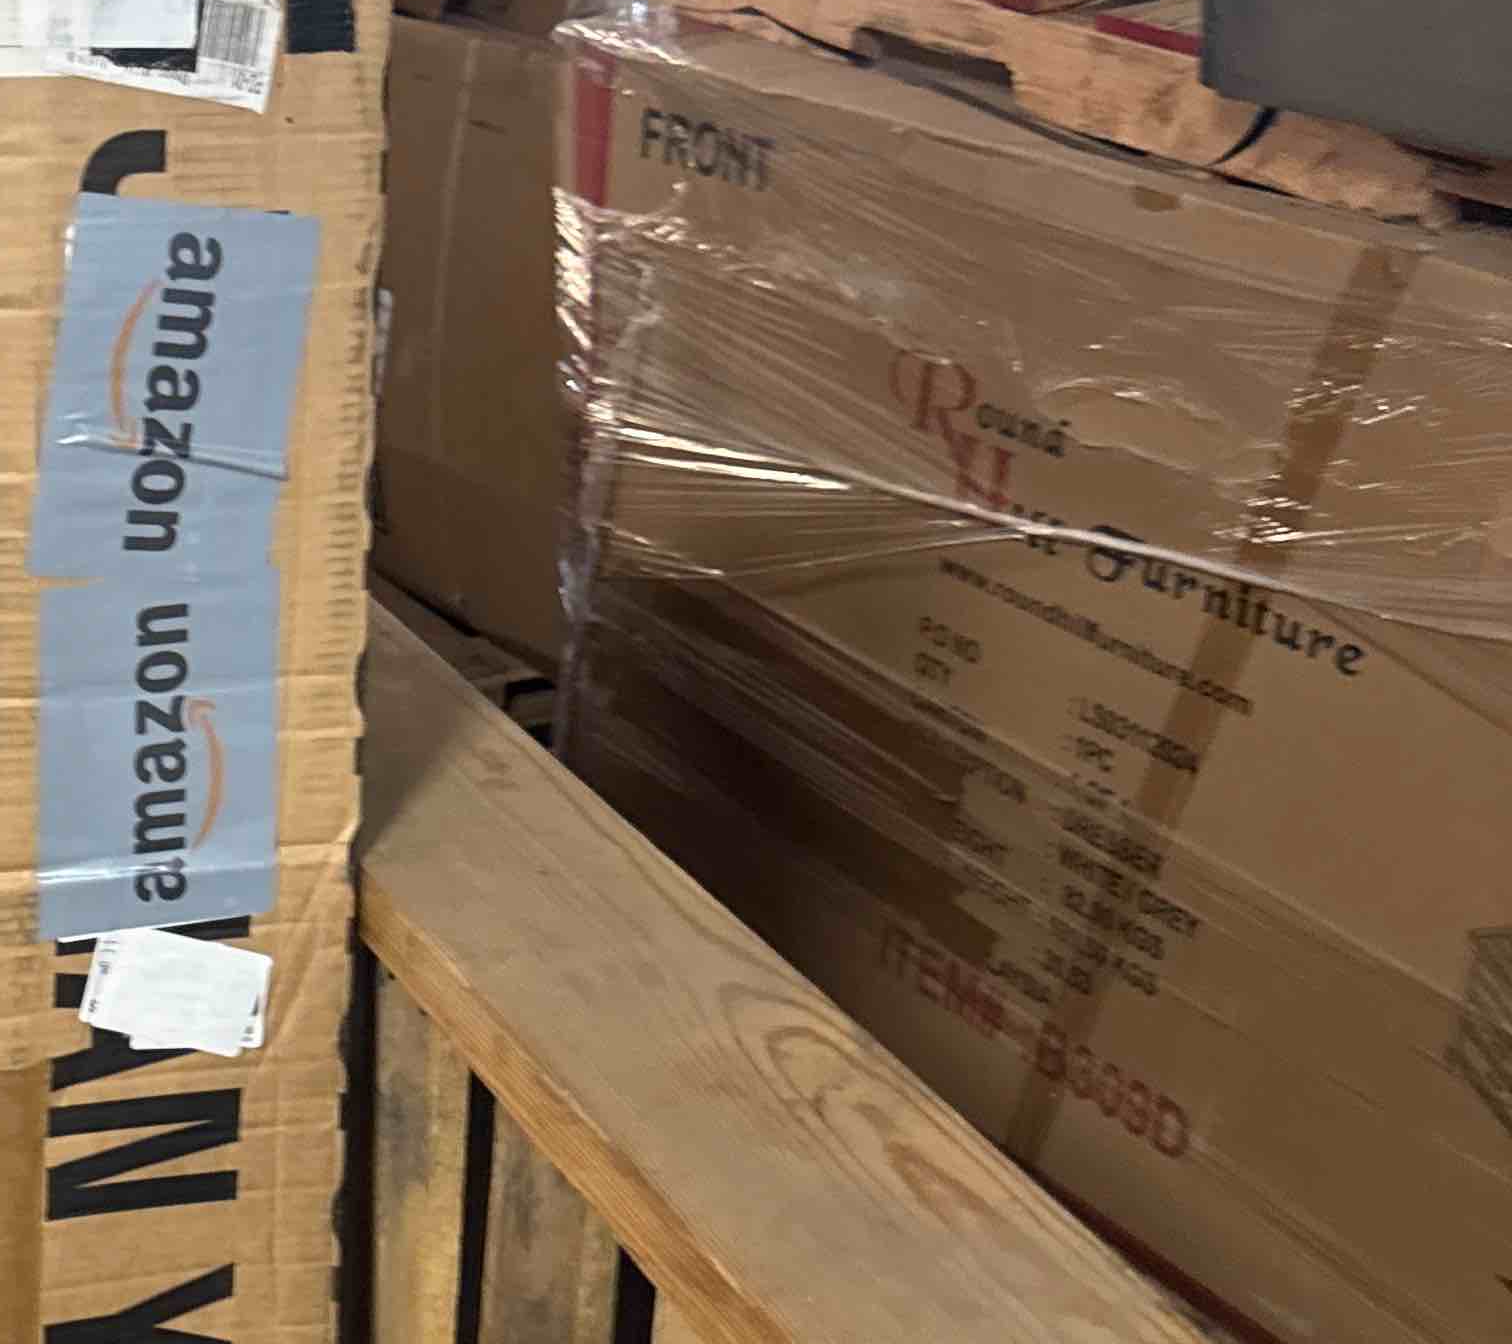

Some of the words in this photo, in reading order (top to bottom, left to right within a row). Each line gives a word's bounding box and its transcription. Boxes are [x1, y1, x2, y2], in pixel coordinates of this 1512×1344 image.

[640, 106, 777, 193] FRONT
[122, 231, 223, 553] amazon
[1085, 524, 1367, 677] Furniture
[133, 602, 188, 904] amazon
